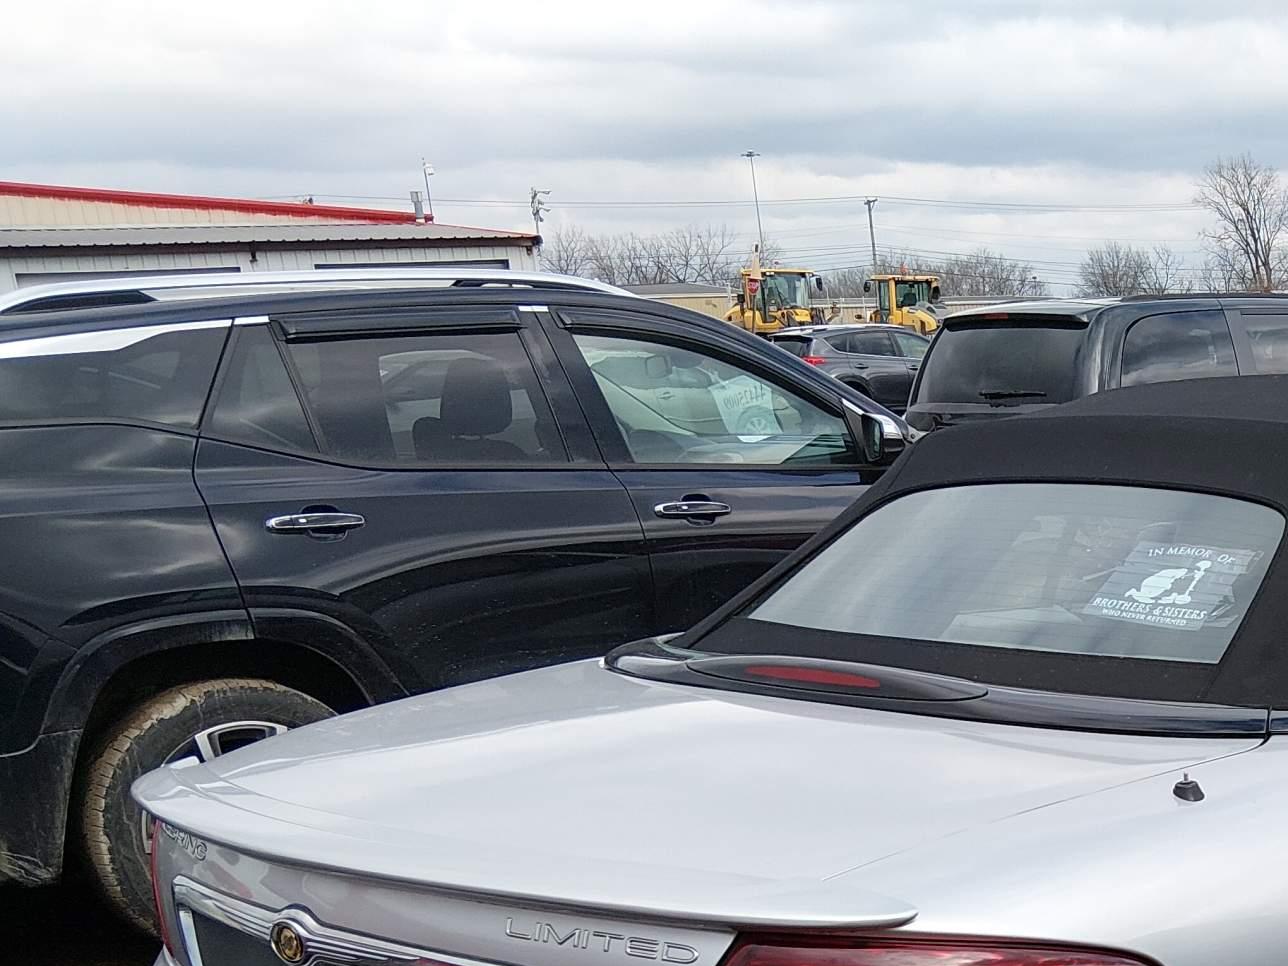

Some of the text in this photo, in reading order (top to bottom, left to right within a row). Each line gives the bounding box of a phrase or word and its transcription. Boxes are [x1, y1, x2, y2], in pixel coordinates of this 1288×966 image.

[1148, 547, 1165, 557] IN
[1217, 553, 1236, 565] OF
[1092, 597, 1152, 614] BROTHERS
[1162, 606, 1208, 619] SISTERS
[1102, 608, 1187, 626] WHO NEVER RETURNED
[505, 917, 700, 964] LIMITED
